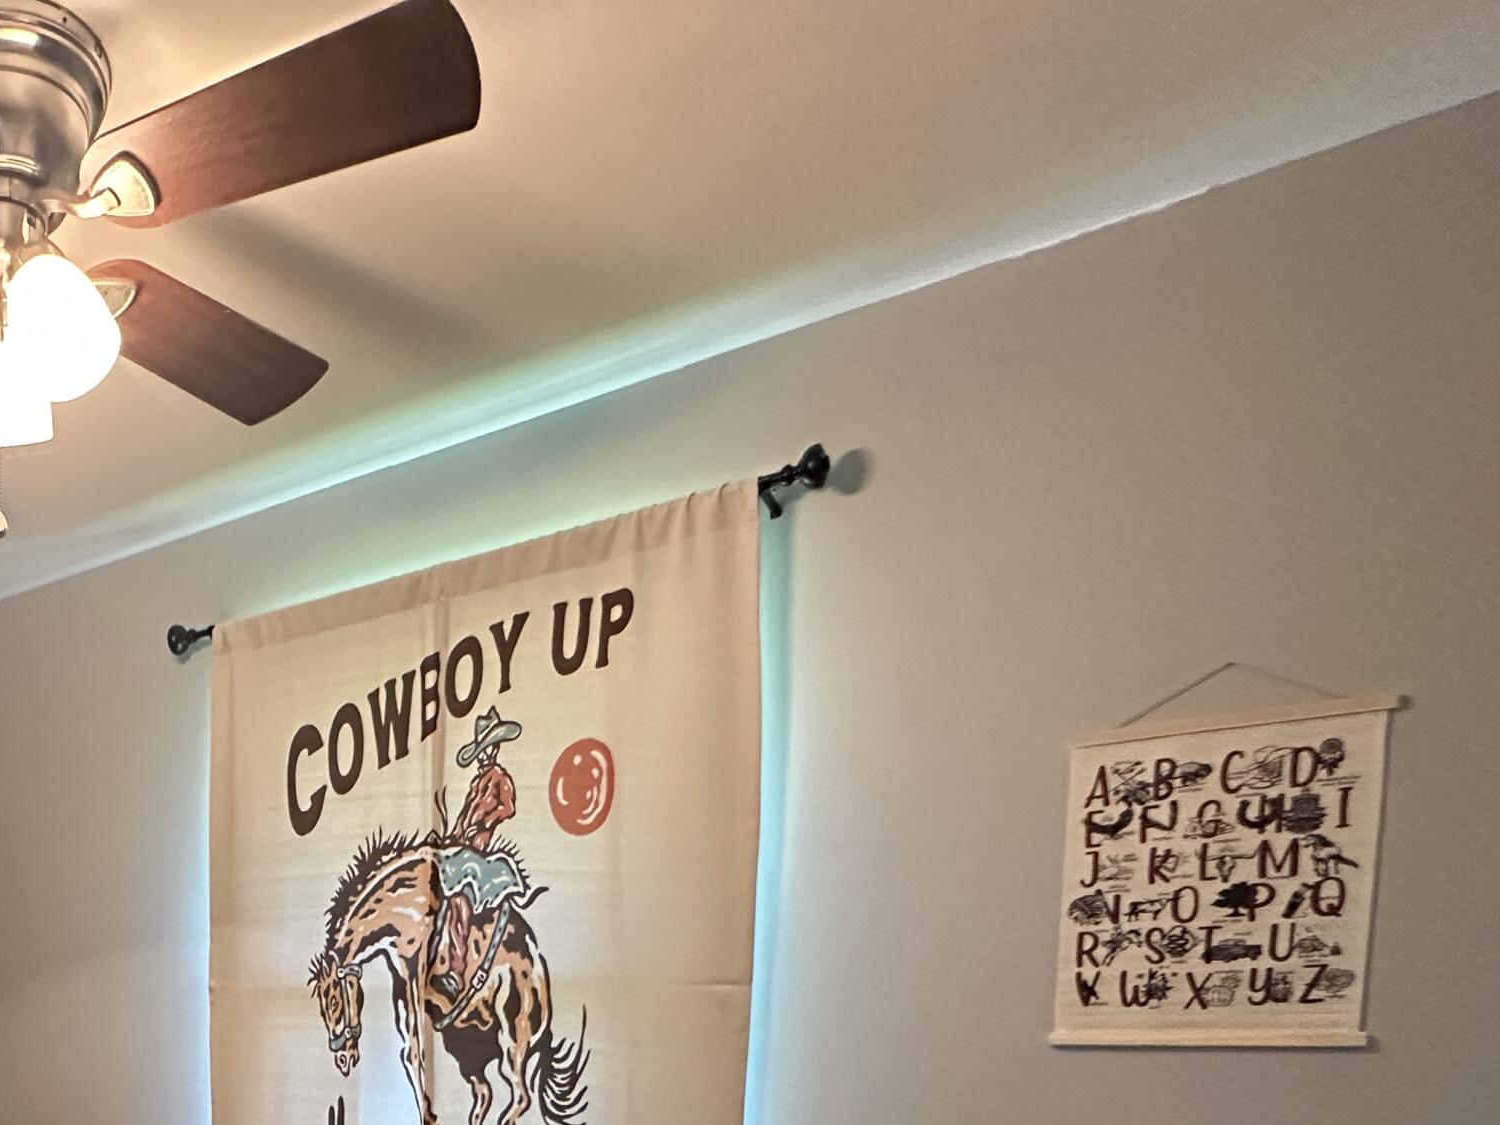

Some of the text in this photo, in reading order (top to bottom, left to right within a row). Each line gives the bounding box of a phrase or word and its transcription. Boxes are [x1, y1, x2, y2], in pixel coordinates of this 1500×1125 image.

[287, 588, 634, 836] COWBOY UP
[1084, 746, 1318, 808] A B C D
[1084, 810, 1103, 849] E
[1197, 799, 1222, 838] G
[1334, 786, 1353, 829] I
[1080, 838, 1298, 888] J K L M
[1170, 885, 1199, 924] O
[1248, 883, 1276, 921] P
[1311, 876, 1346, 917] Q
[1077, 931, 1100, 968] R
[1144, 927, 1165, 964] S
[1269, 922, 1296, 962] U
[1298, 963, 1328, 1003] Z
